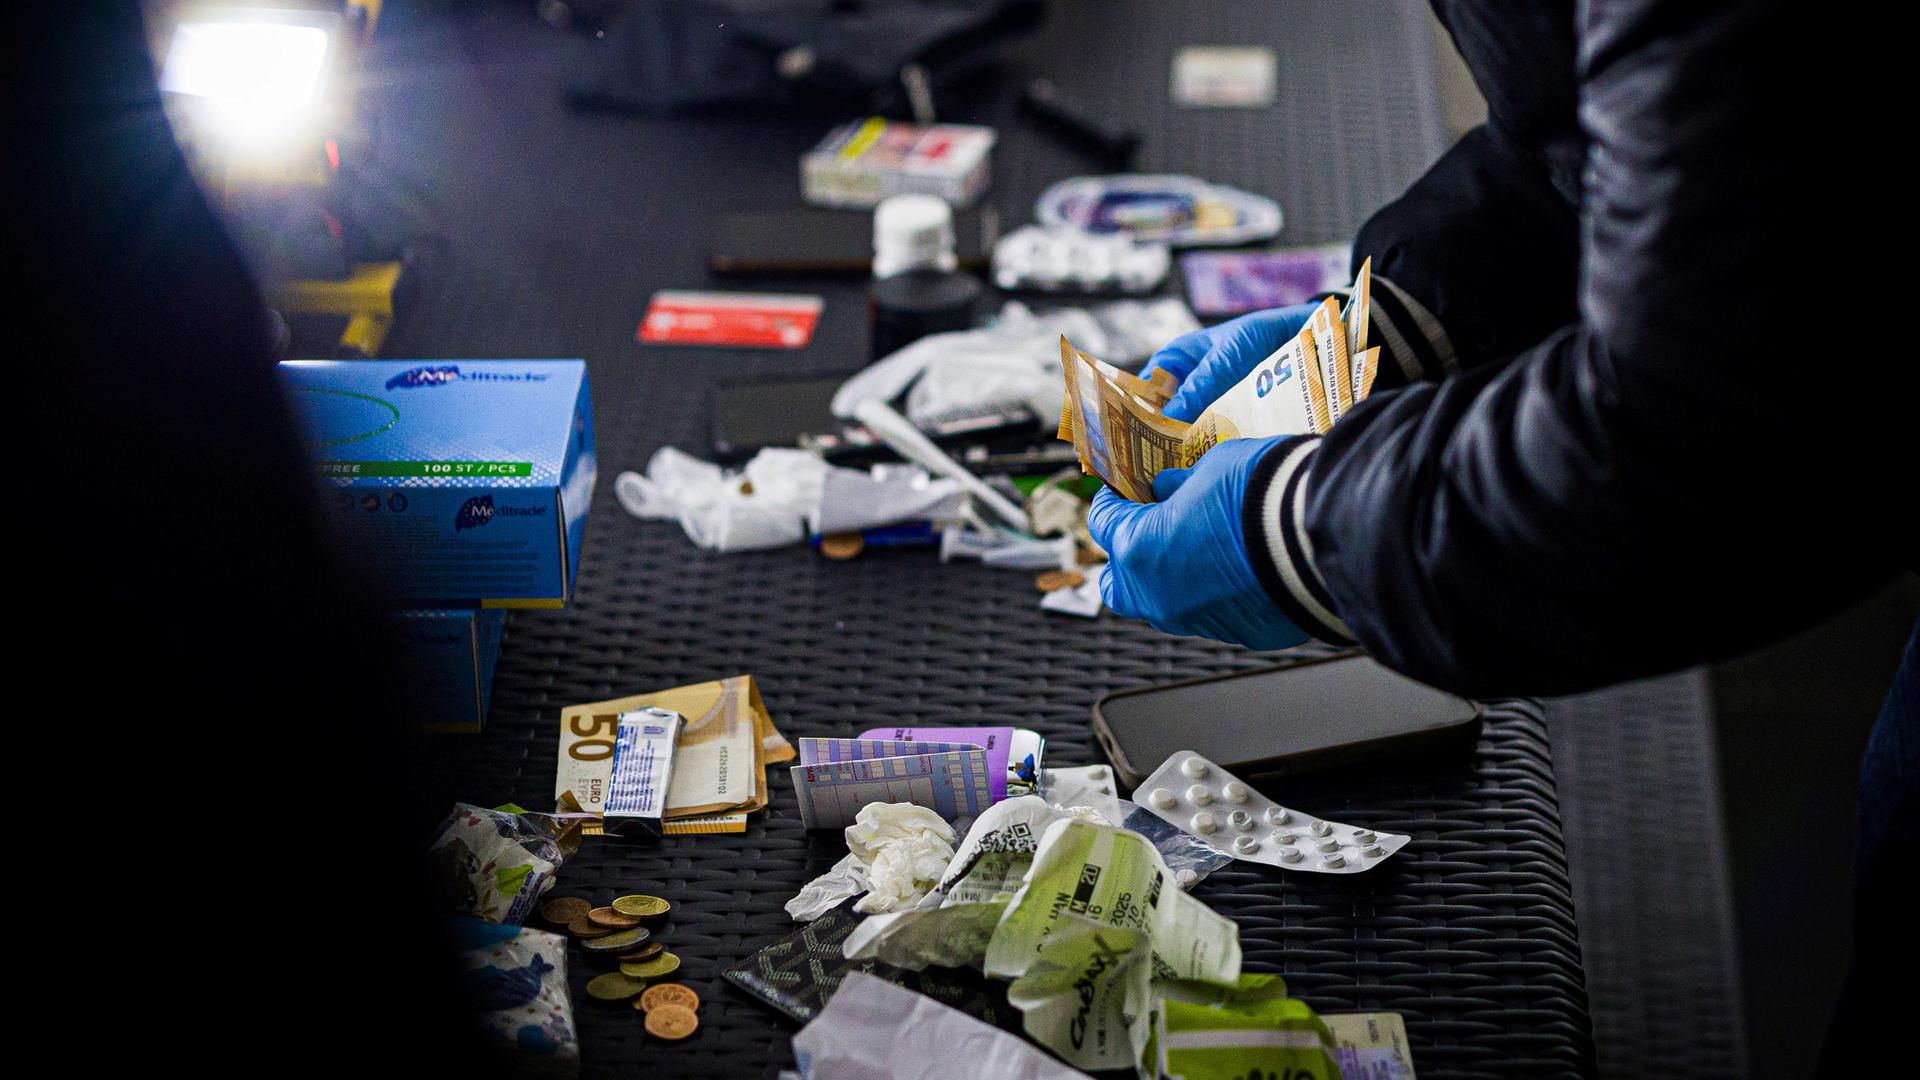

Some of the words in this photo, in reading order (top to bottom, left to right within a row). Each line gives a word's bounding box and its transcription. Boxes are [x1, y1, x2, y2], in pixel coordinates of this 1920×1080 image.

[1255, 353, 1292, 398] 50
[322, 464, 361, 473] FREE
[423, 464, 451, 473] 100
[456, 464, 475, 473] ST
[488, 464, 517, 473] PCS
[471, 504, 547, 517] Meditrade
[568, 714, 618, 762] 50
[590, 779, 602, 804] EURO
[1109, 890, 1133, 928] 2025
